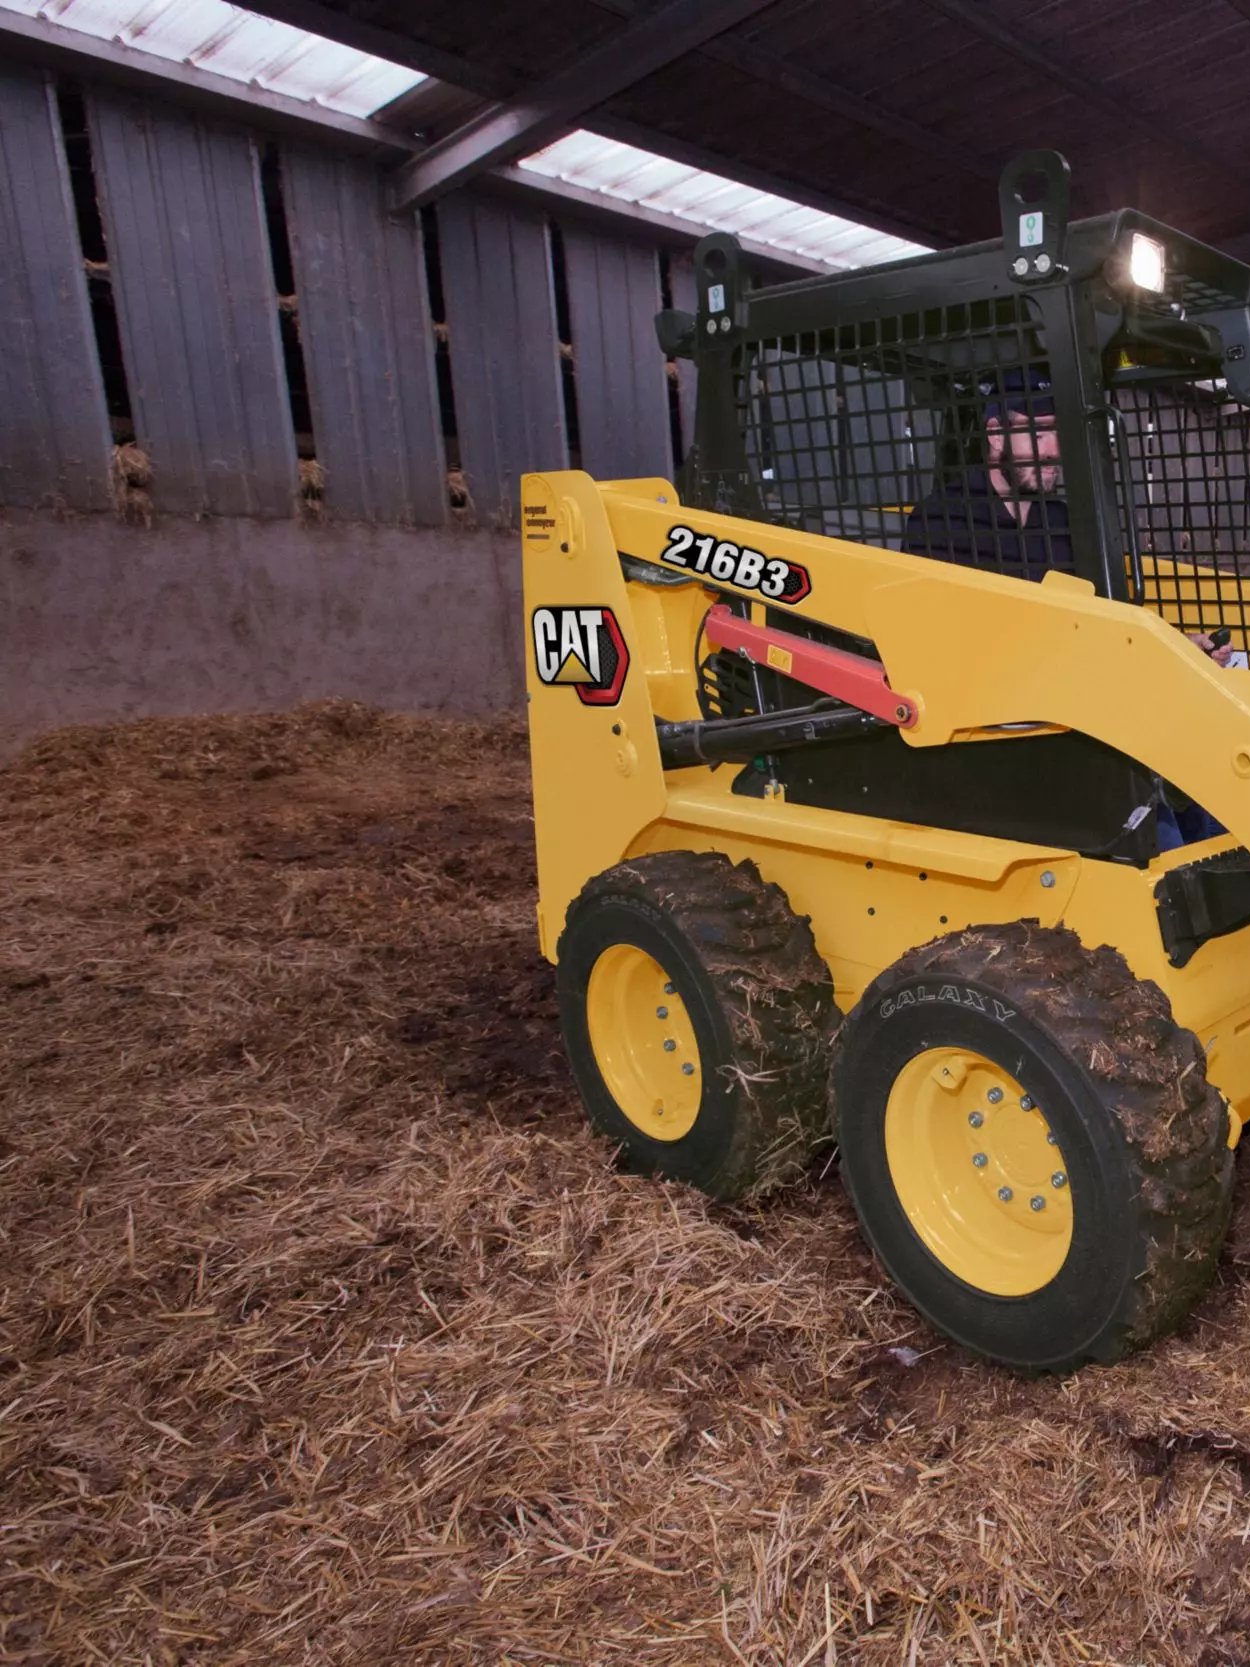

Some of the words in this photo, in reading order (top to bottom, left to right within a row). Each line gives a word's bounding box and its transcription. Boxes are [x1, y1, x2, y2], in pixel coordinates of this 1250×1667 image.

[663, 526, 790, 597] 216B3
[533, 608, 604, 683] CAT
[879, 984, 1016, 1022] GALAXY
